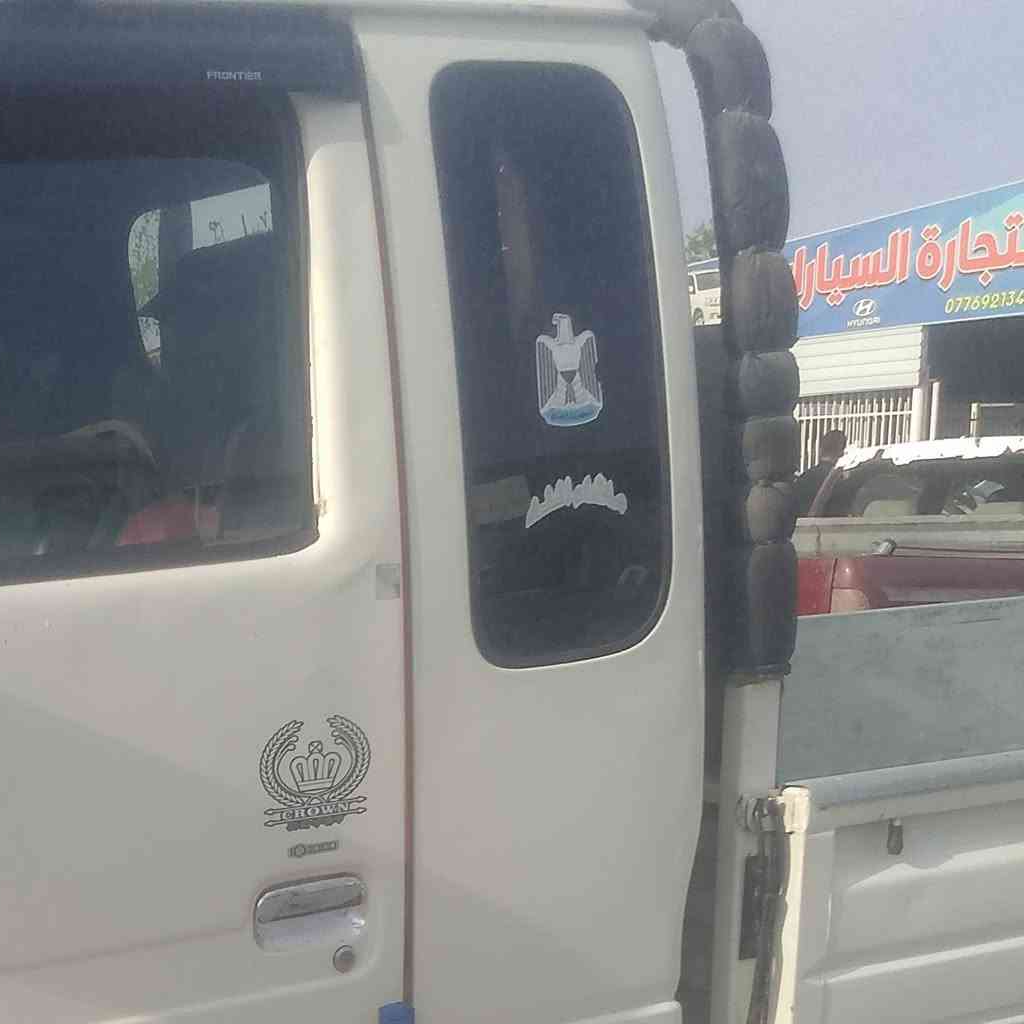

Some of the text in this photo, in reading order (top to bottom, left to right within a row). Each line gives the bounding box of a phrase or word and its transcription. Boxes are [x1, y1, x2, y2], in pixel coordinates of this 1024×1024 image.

[790, 211, 1024, 311] تجارة السيارا
[279, 800, 351, 821] CROWN
